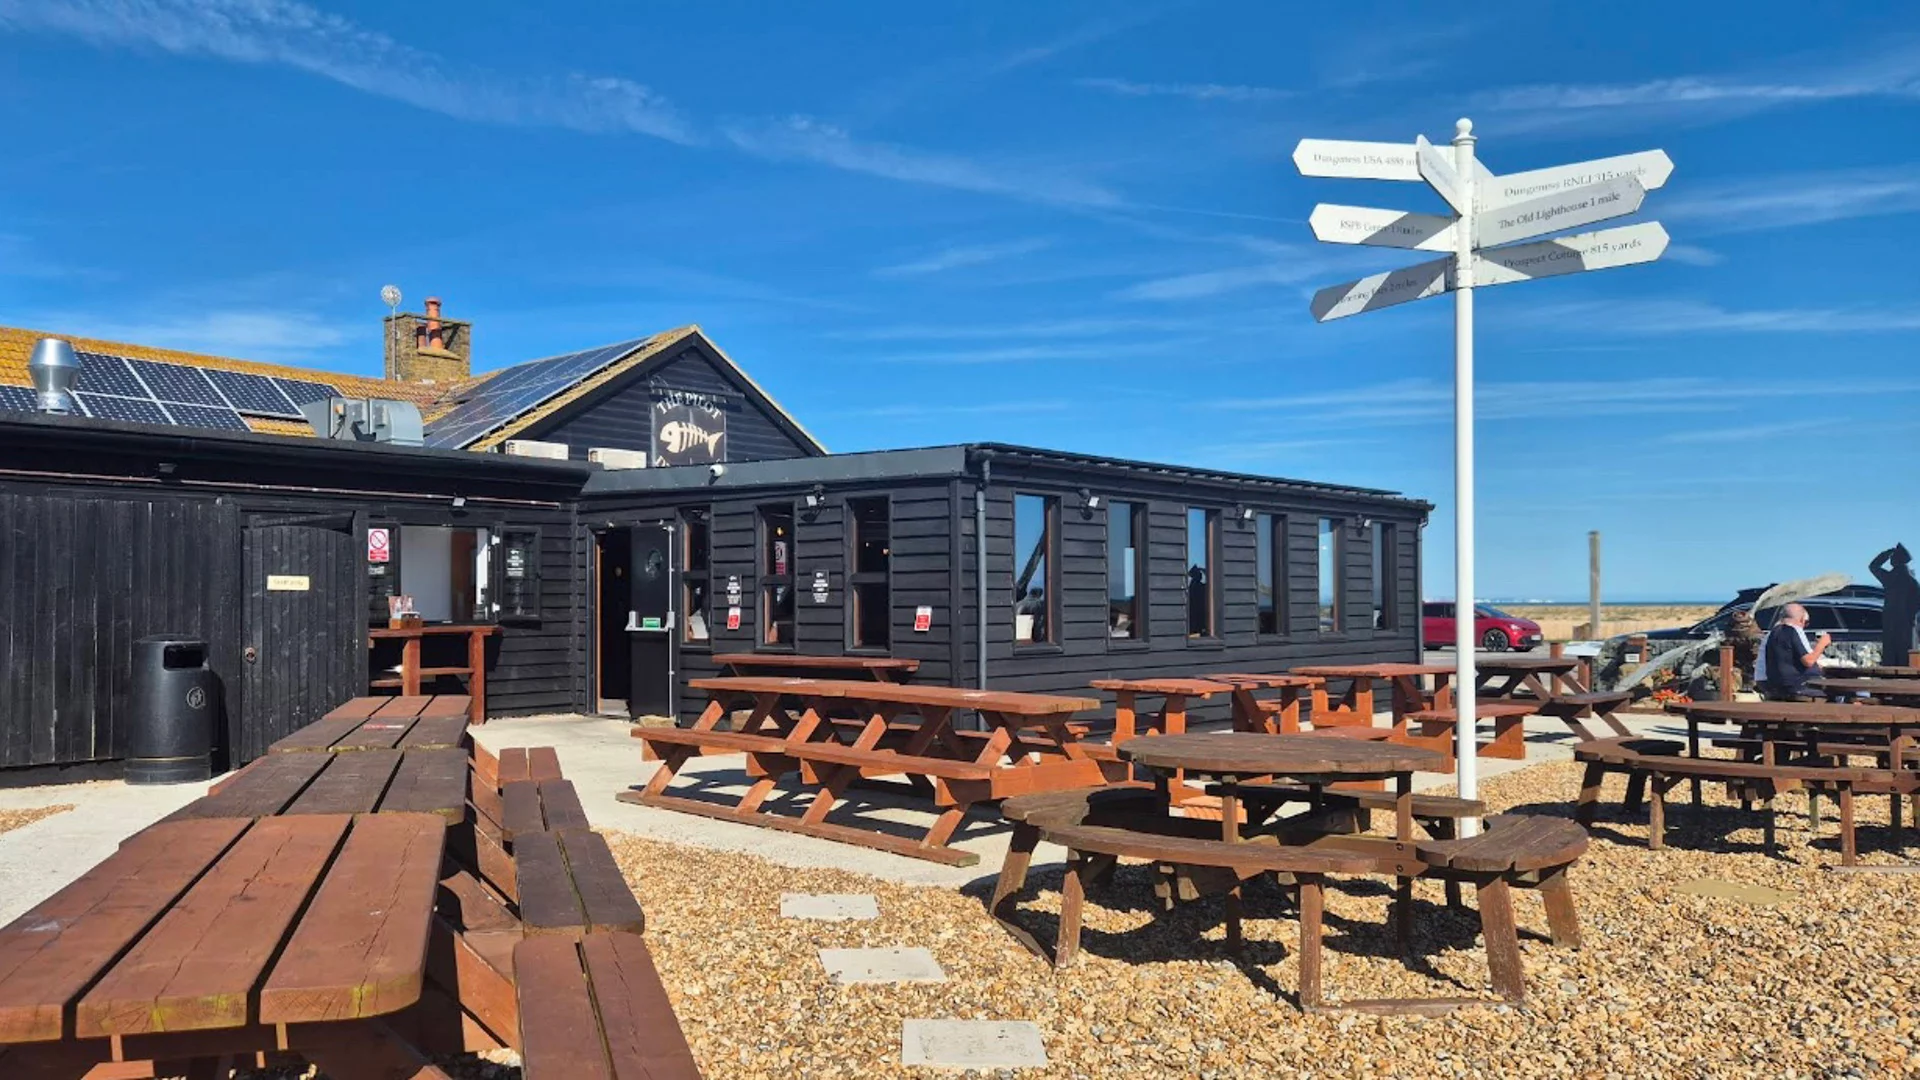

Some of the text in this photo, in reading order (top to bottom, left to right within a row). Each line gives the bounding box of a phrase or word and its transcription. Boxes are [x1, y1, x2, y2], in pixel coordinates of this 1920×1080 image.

[1503, 180, 1561, 197] Dungeness
[1563, 173, 1592, 188] RNLI
[1498, 191, 1622, 229] The Old Lighthouse 1 mile
[1504, 238, 1642, 268] Prospect Cottage 815 yards
[657, 393, 722, 419] THE PILOT
